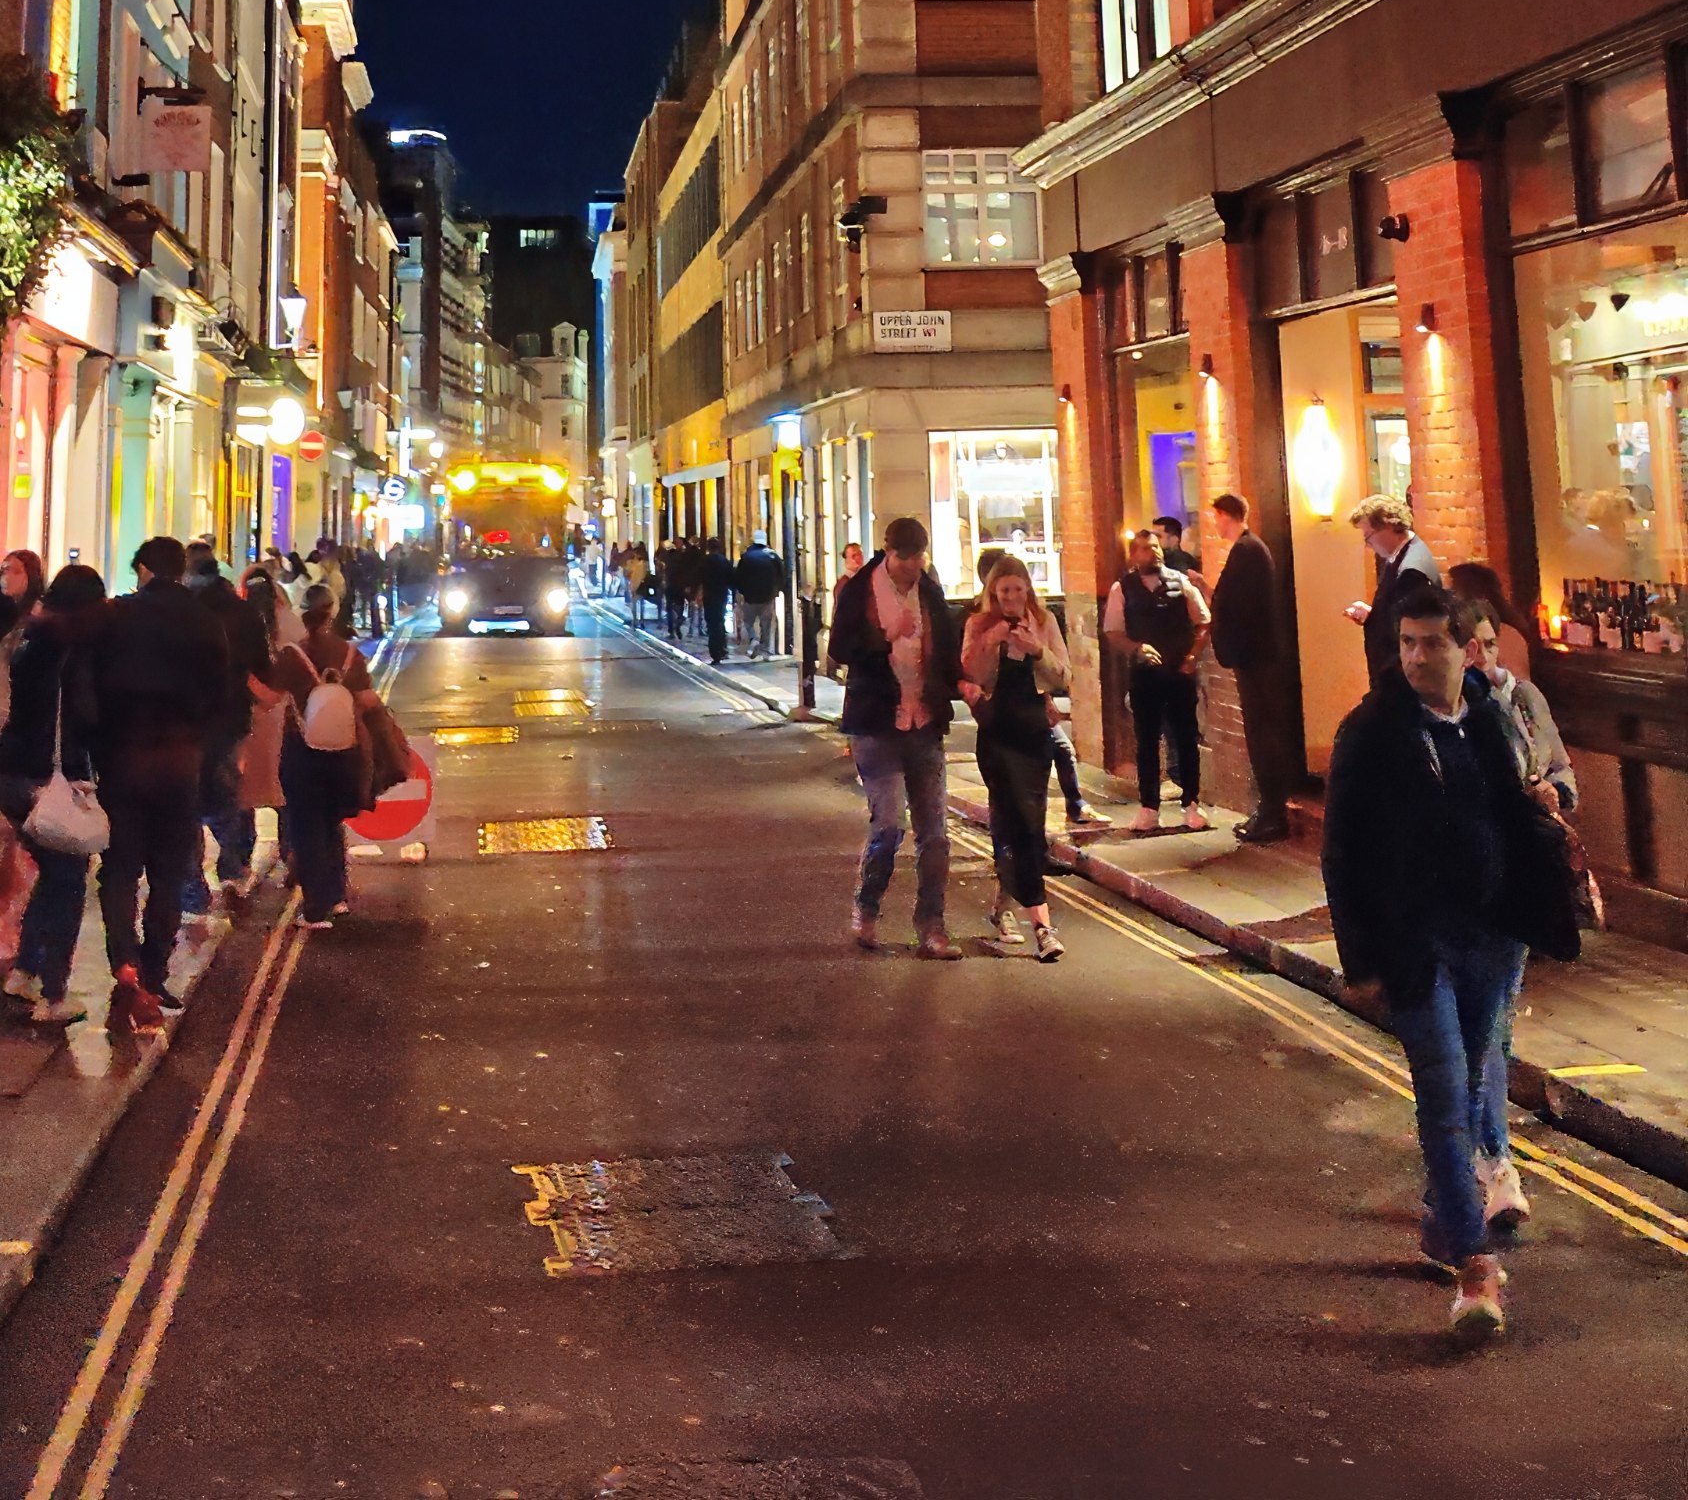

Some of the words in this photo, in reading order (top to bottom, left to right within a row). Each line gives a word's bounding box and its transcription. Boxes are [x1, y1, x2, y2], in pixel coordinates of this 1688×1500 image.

[880, 315, 912, 326] UPPER
[916, 315, 945, 326] JOHN
[880, 327, 917, 339] STREET
[922, 328, 937, 337] W1
